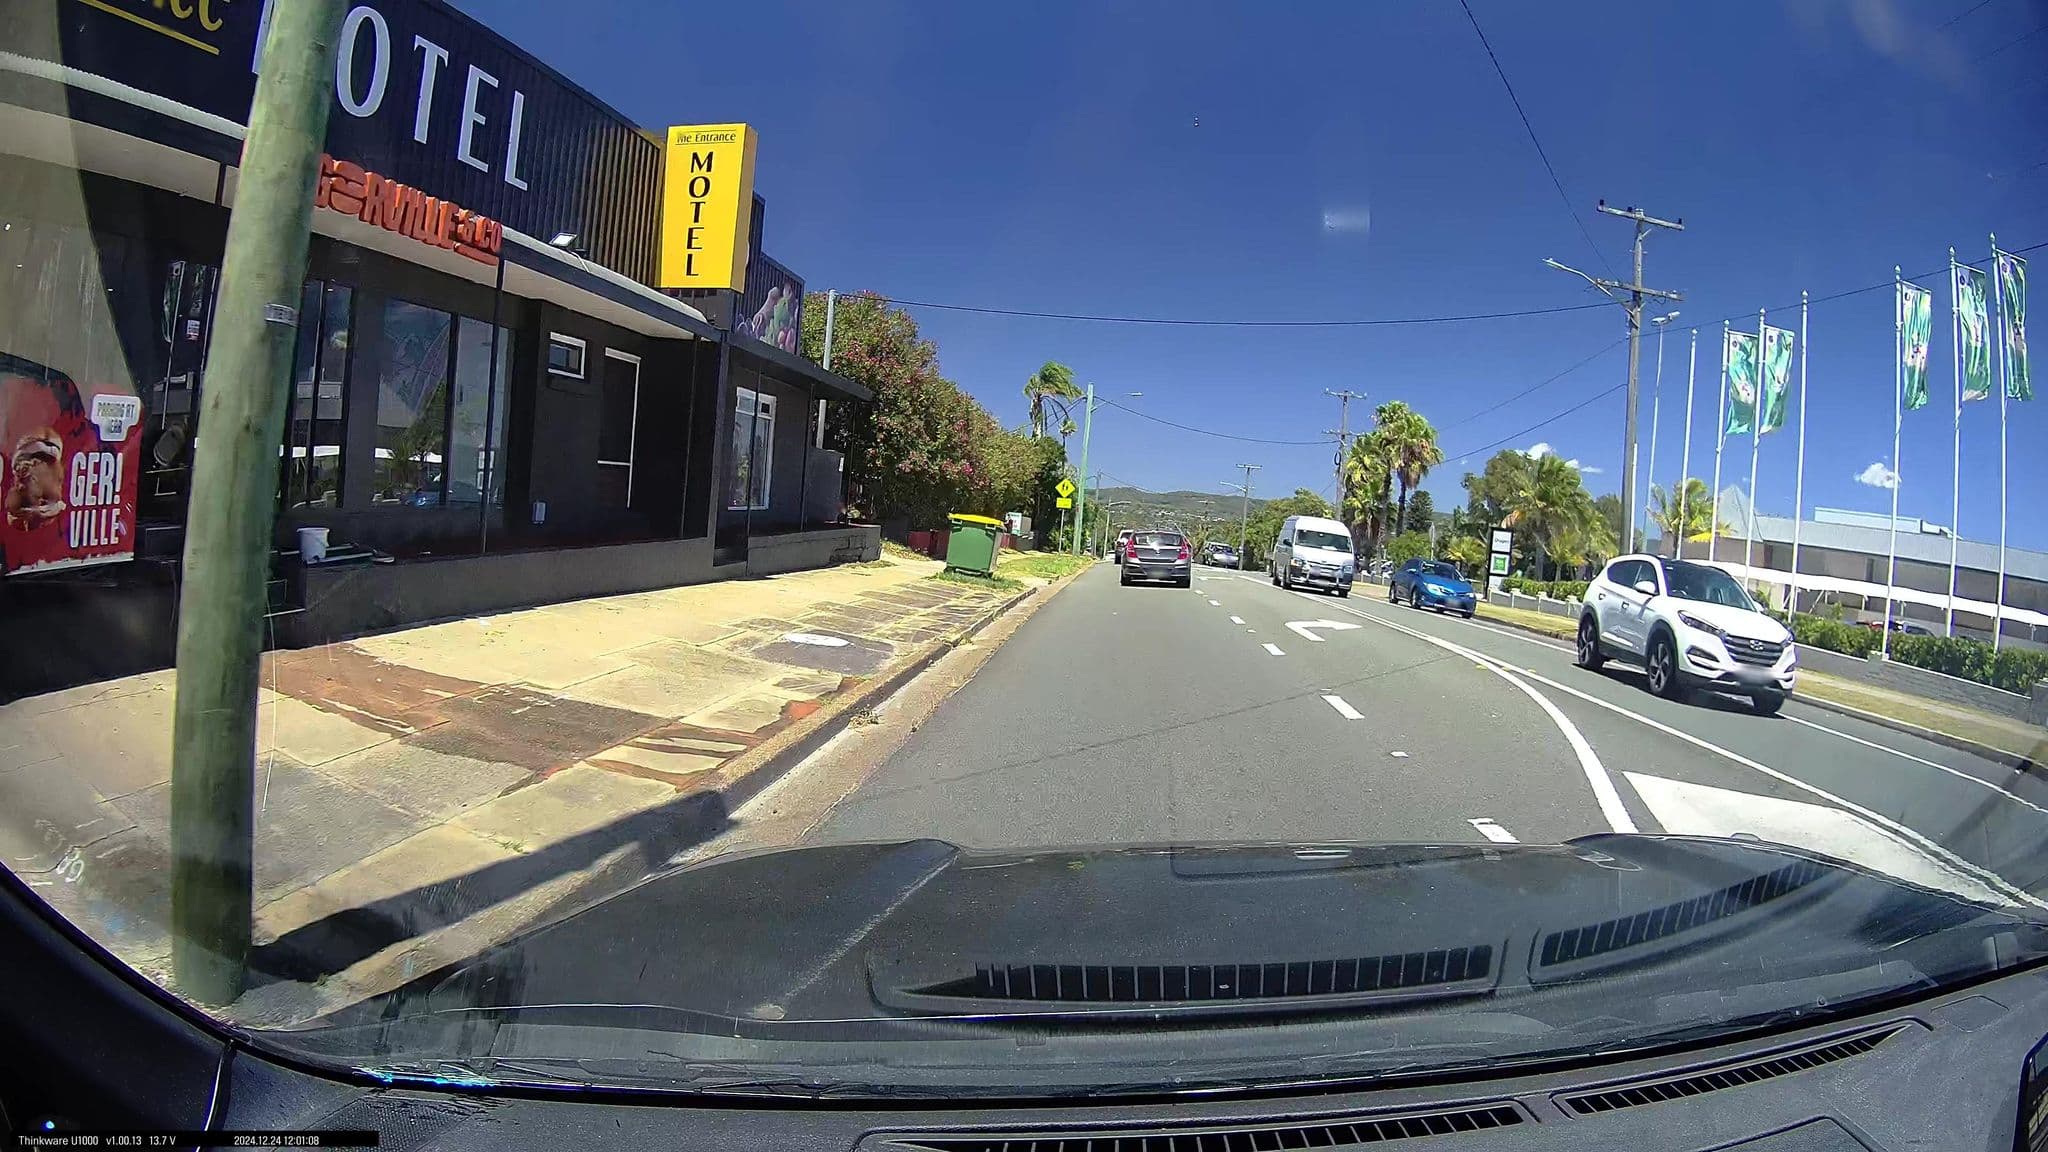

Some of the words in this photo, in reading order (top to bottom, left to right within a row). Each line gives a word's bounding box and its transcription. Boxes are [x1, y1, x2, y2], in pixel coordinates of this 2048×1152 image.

[252, 0, 527, 191] OTEL
[694, 131, 737, 143] Entrance
[686, 151, 713, 276] MOTEL
[69, 452, 124, 507] GER!
[69, 508, 121, 548] VILLE
